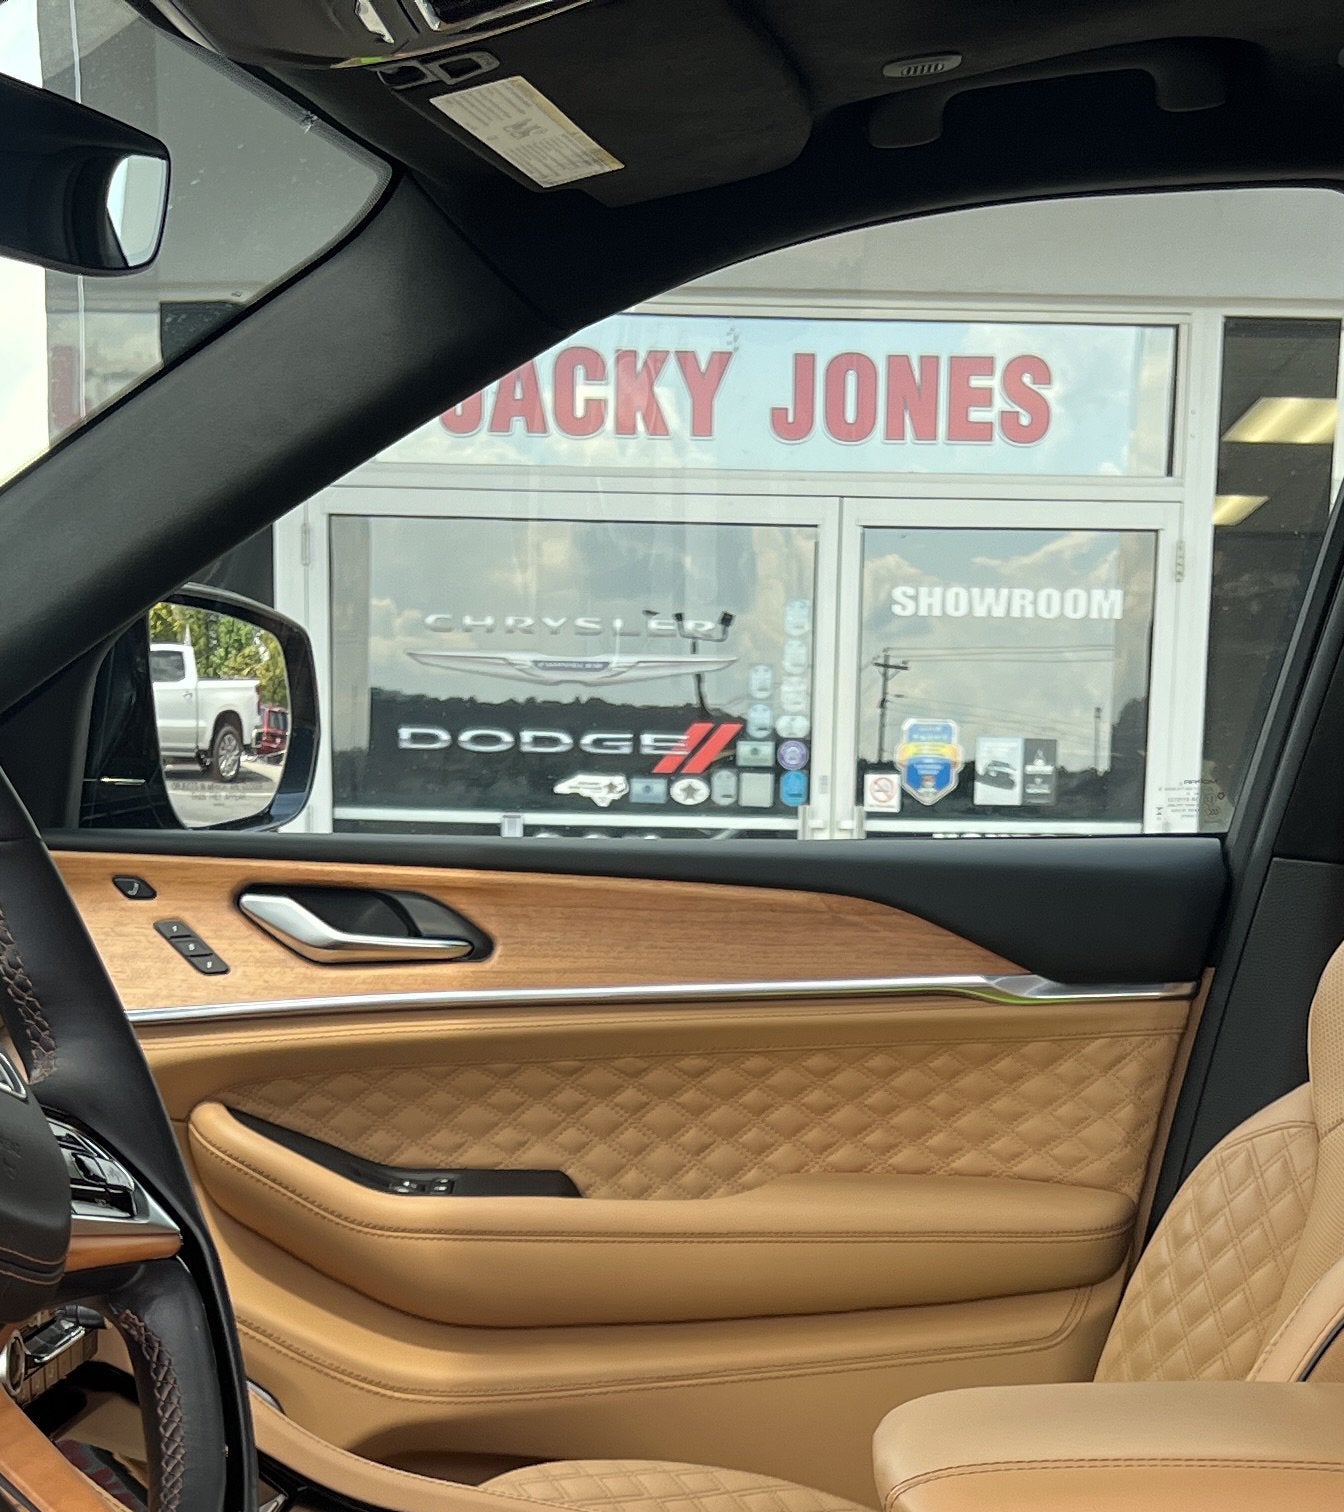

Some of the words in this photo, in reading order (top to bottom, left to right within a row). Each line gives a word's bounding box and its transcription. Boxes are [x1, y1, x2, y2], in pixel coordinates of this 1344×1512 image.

[770, 352, 1052, 444] JONES
[890, 585, 1125, 620] SHOWROOM
[424, 613, 718, 638] CHRYSLER
[397, 725, 691, 756] DODGE
